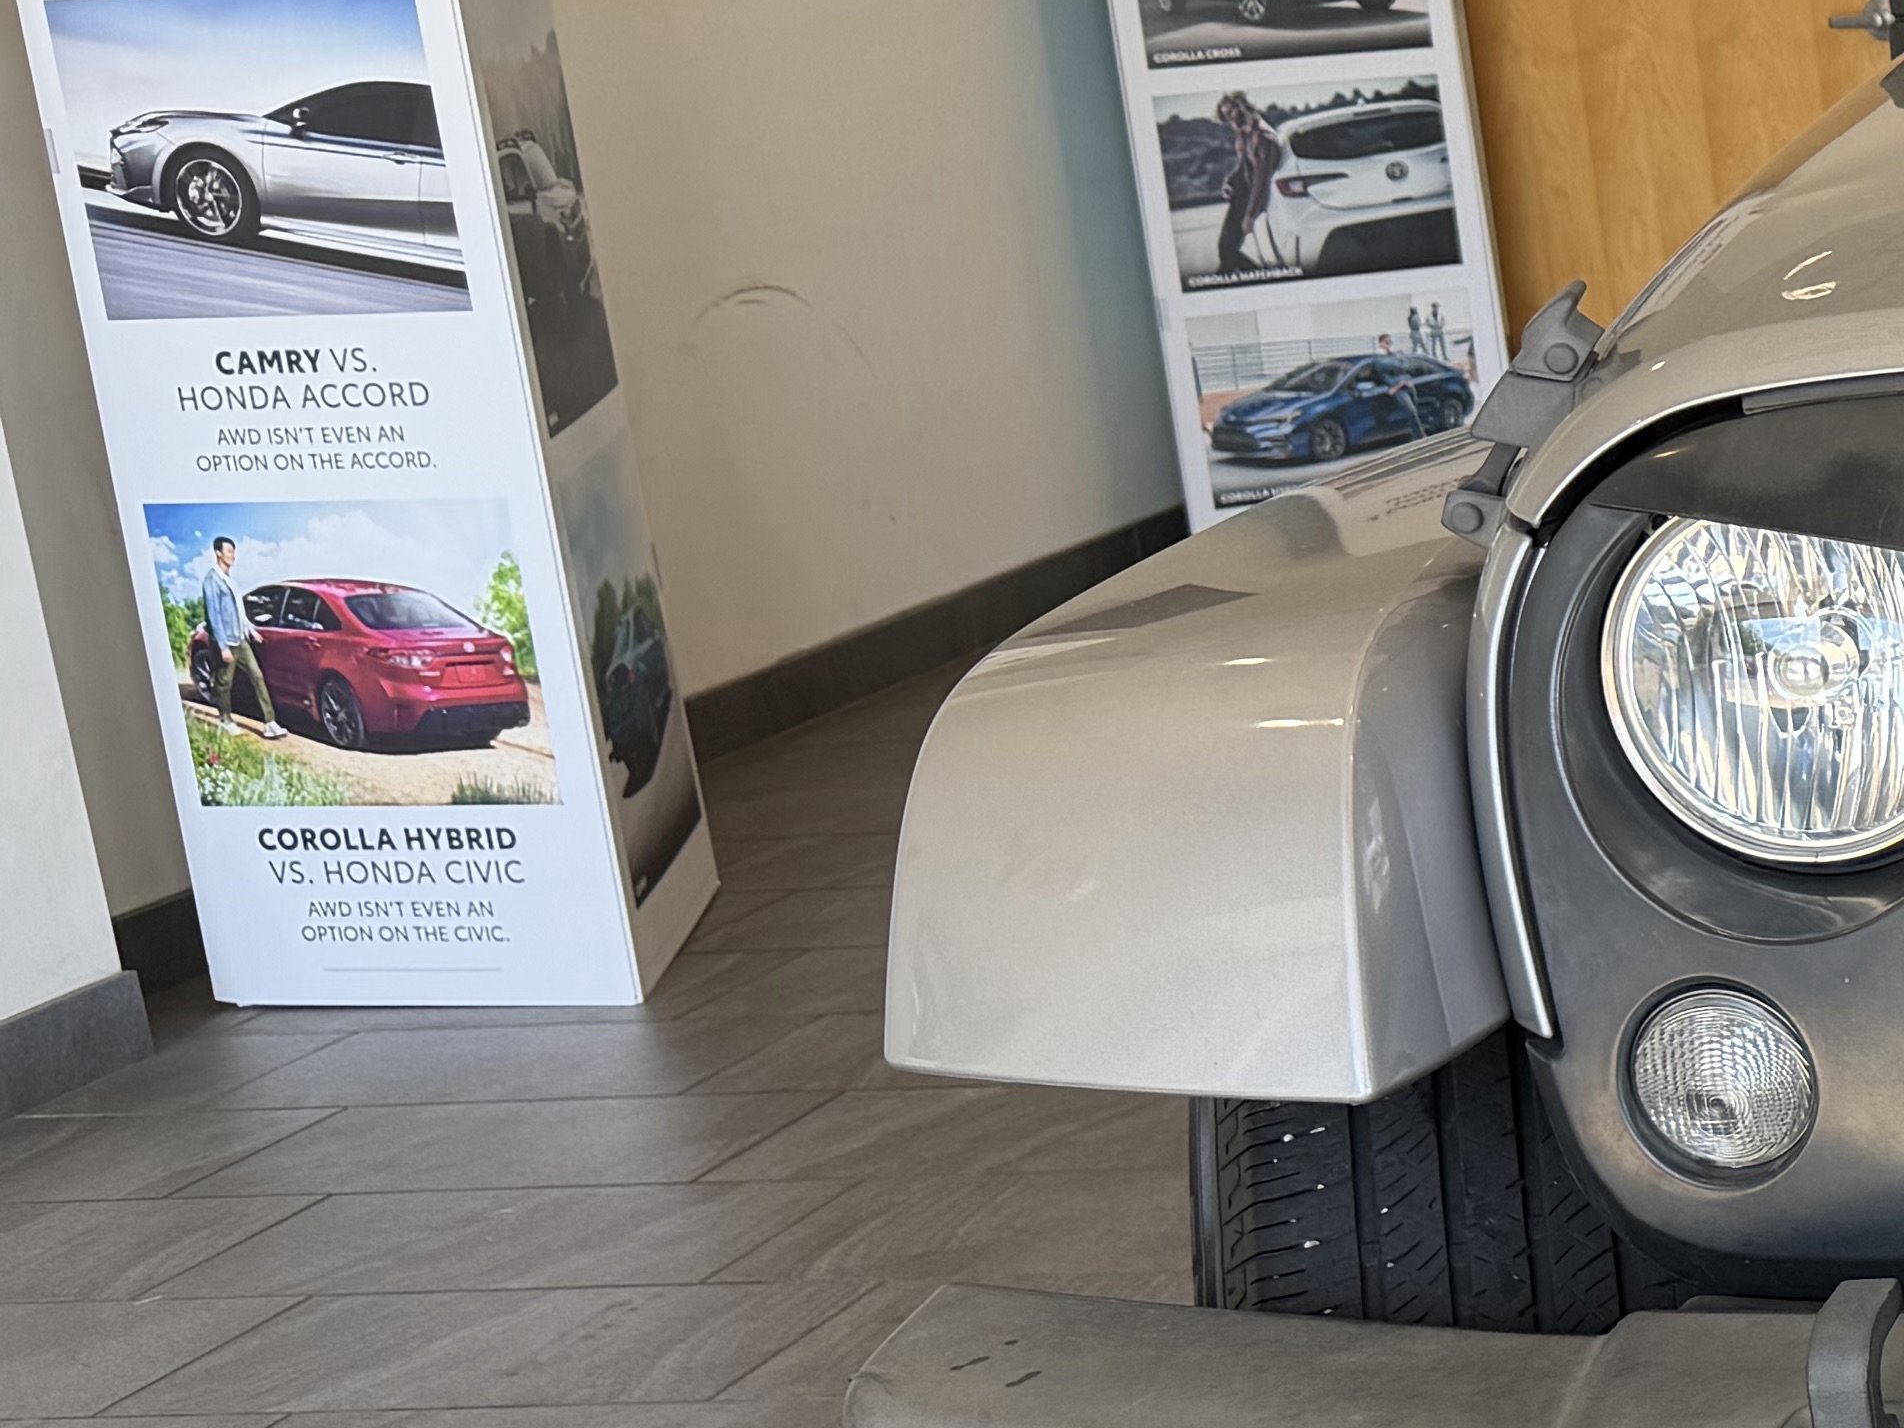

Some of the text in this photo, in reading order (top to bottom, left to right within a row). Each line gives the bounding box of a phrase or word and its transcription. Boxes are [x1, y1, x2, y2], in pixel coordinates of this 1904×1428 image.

[1153, 49, 1205, 64] COROLLA
[1188, 273, 1239, 288] COROLLA
[215, 348, 378, 375] CAMRY VS.
[178, 382, 429, 411] HONDA ACCORD
[217, 425, 405, 446] AWD ISN'T EVEN AN
[196, 450, 437, 472] OPTION ON THE ACCORD.
[258, 827, 517, 851] COROLLA HYBRID
[268, 860, 526, 884] VS. HONDA CIVIC
[308, 901, 495, 917] AWD ISN'T EVEN AN
[301, 925, 511, 942] OPTION ON THE CIVIC.
